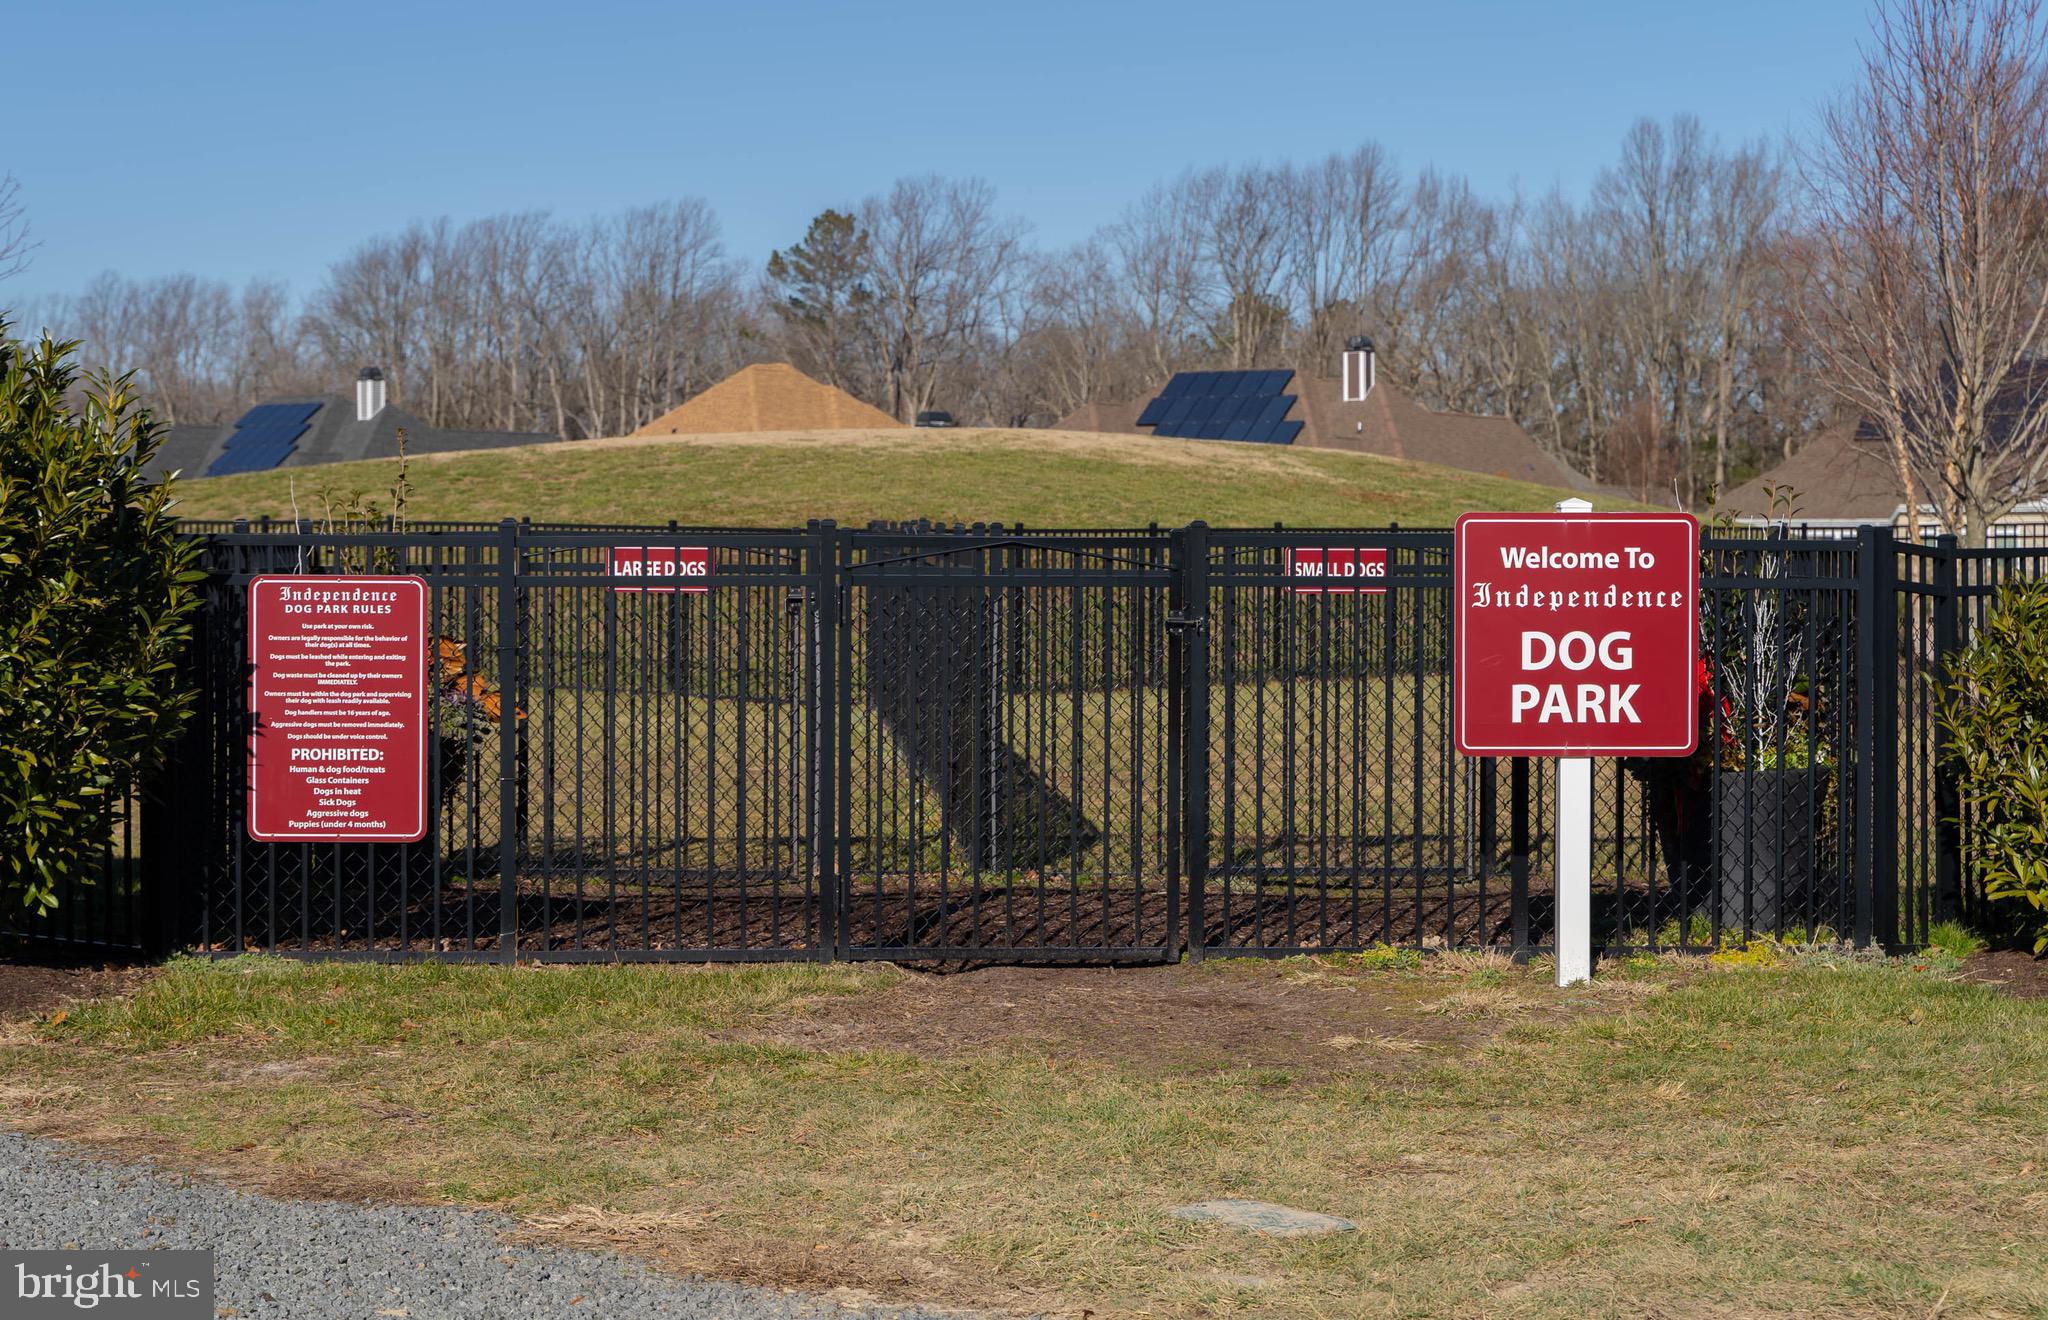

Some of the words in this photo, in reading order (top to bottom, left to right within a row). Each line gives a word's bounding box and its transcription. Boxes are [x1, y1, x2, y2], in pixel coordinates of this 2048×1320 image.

[1500, 546, 1619, 569] Welcome
[1624, 548, 1655, 569] To
[665, 561, 706, 576] DOGS
[1296, 563, 1341, 576] SMALL
[1345, 563, 1385, 576] DOGS
[279, 587, 397, 602] Independence
[1472, 583, 1683, 612] Independence
[285, 604, 312, 613] DOG
[317, 605, 348, 613] PARK
[353, 605, 391, 614] RULES
[1521, 631, 1633, 671] DOG
[1512, 684, 1641, 723] PARK
[292, 748, 384, 760] PROHIBITED:
[326, 766, 342, 774] dog
[314, 788, 334, 796] Dogs
[336, 799, 356, 807] Dogs
[306, 810, 348, 818] Aggressive
[350, 810, 368, 818] dogs
[289, 820, 320, 829] Puppies
[354, 821, 386, 829] months)
